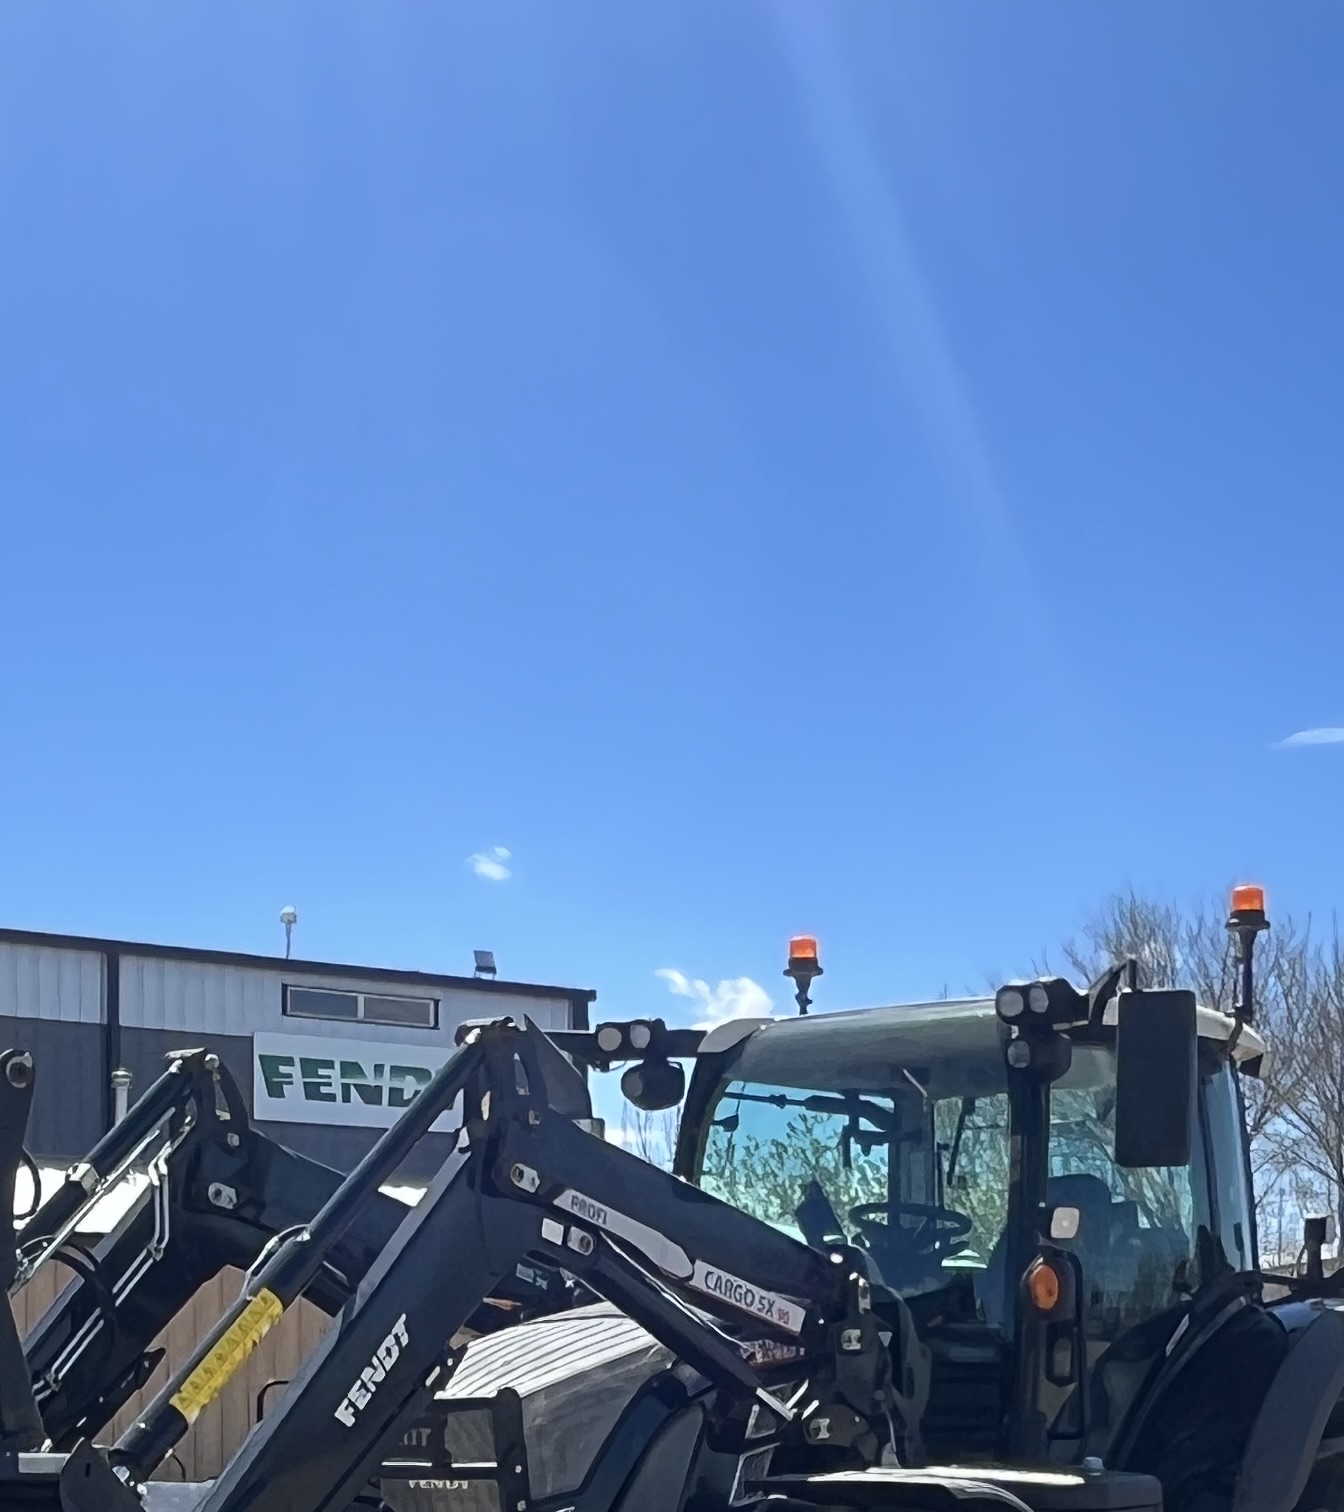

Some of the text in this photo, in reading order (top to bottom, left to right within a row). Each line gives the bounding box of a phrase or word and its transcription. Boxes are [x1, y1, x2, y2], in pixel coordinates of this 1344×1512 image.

[258, 1053, 454, 1110] FEND
[704, 1270, 756, 1308] CARGO
[334, 1313, 409, 1427] FENDT
